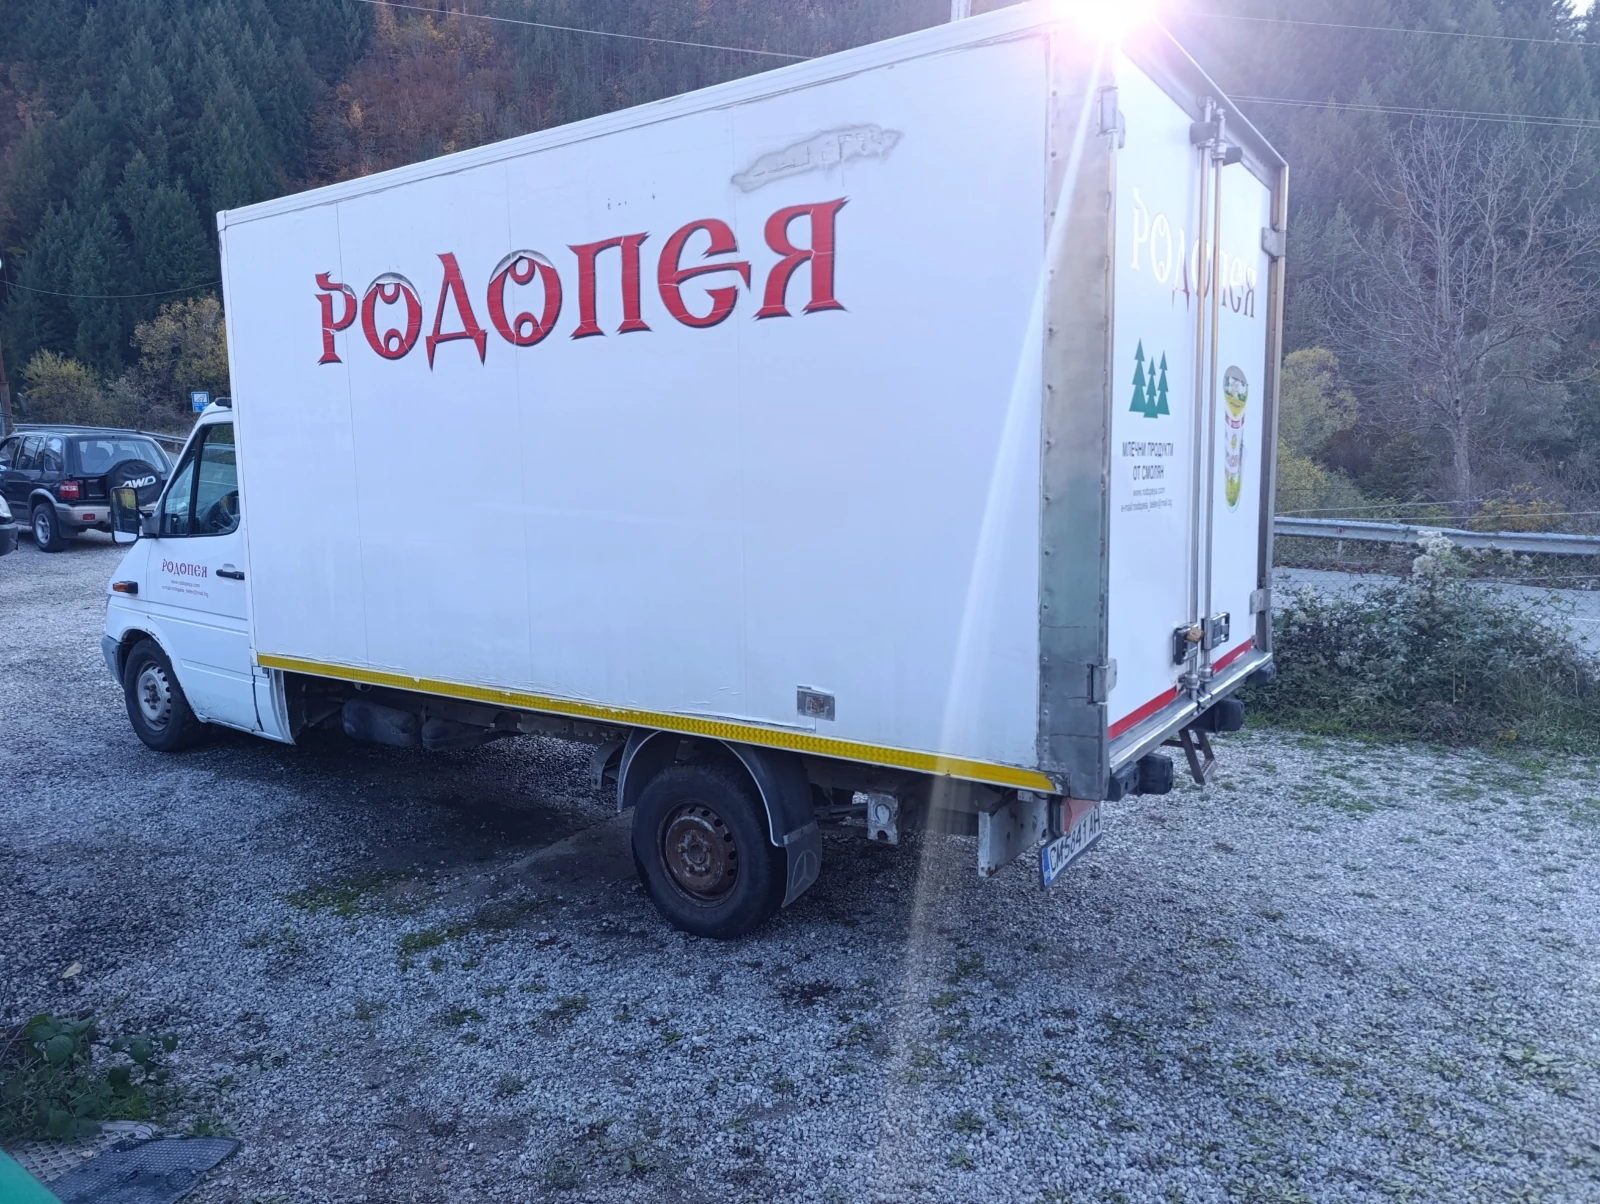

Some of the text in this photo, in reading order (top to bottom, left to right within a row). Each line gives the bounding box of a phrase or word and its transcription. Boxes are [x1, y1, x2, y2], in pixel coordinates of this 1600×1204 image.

[315, 196, 852, 371] РОДОПЕЯ
[1122, 441, 1174, 459] МЛЕЧНИ ПРОДУКТИ
[1132, 464, 1165, 481] ОТ СМОЛЯН
[121, 475, 157, 489] AWD
